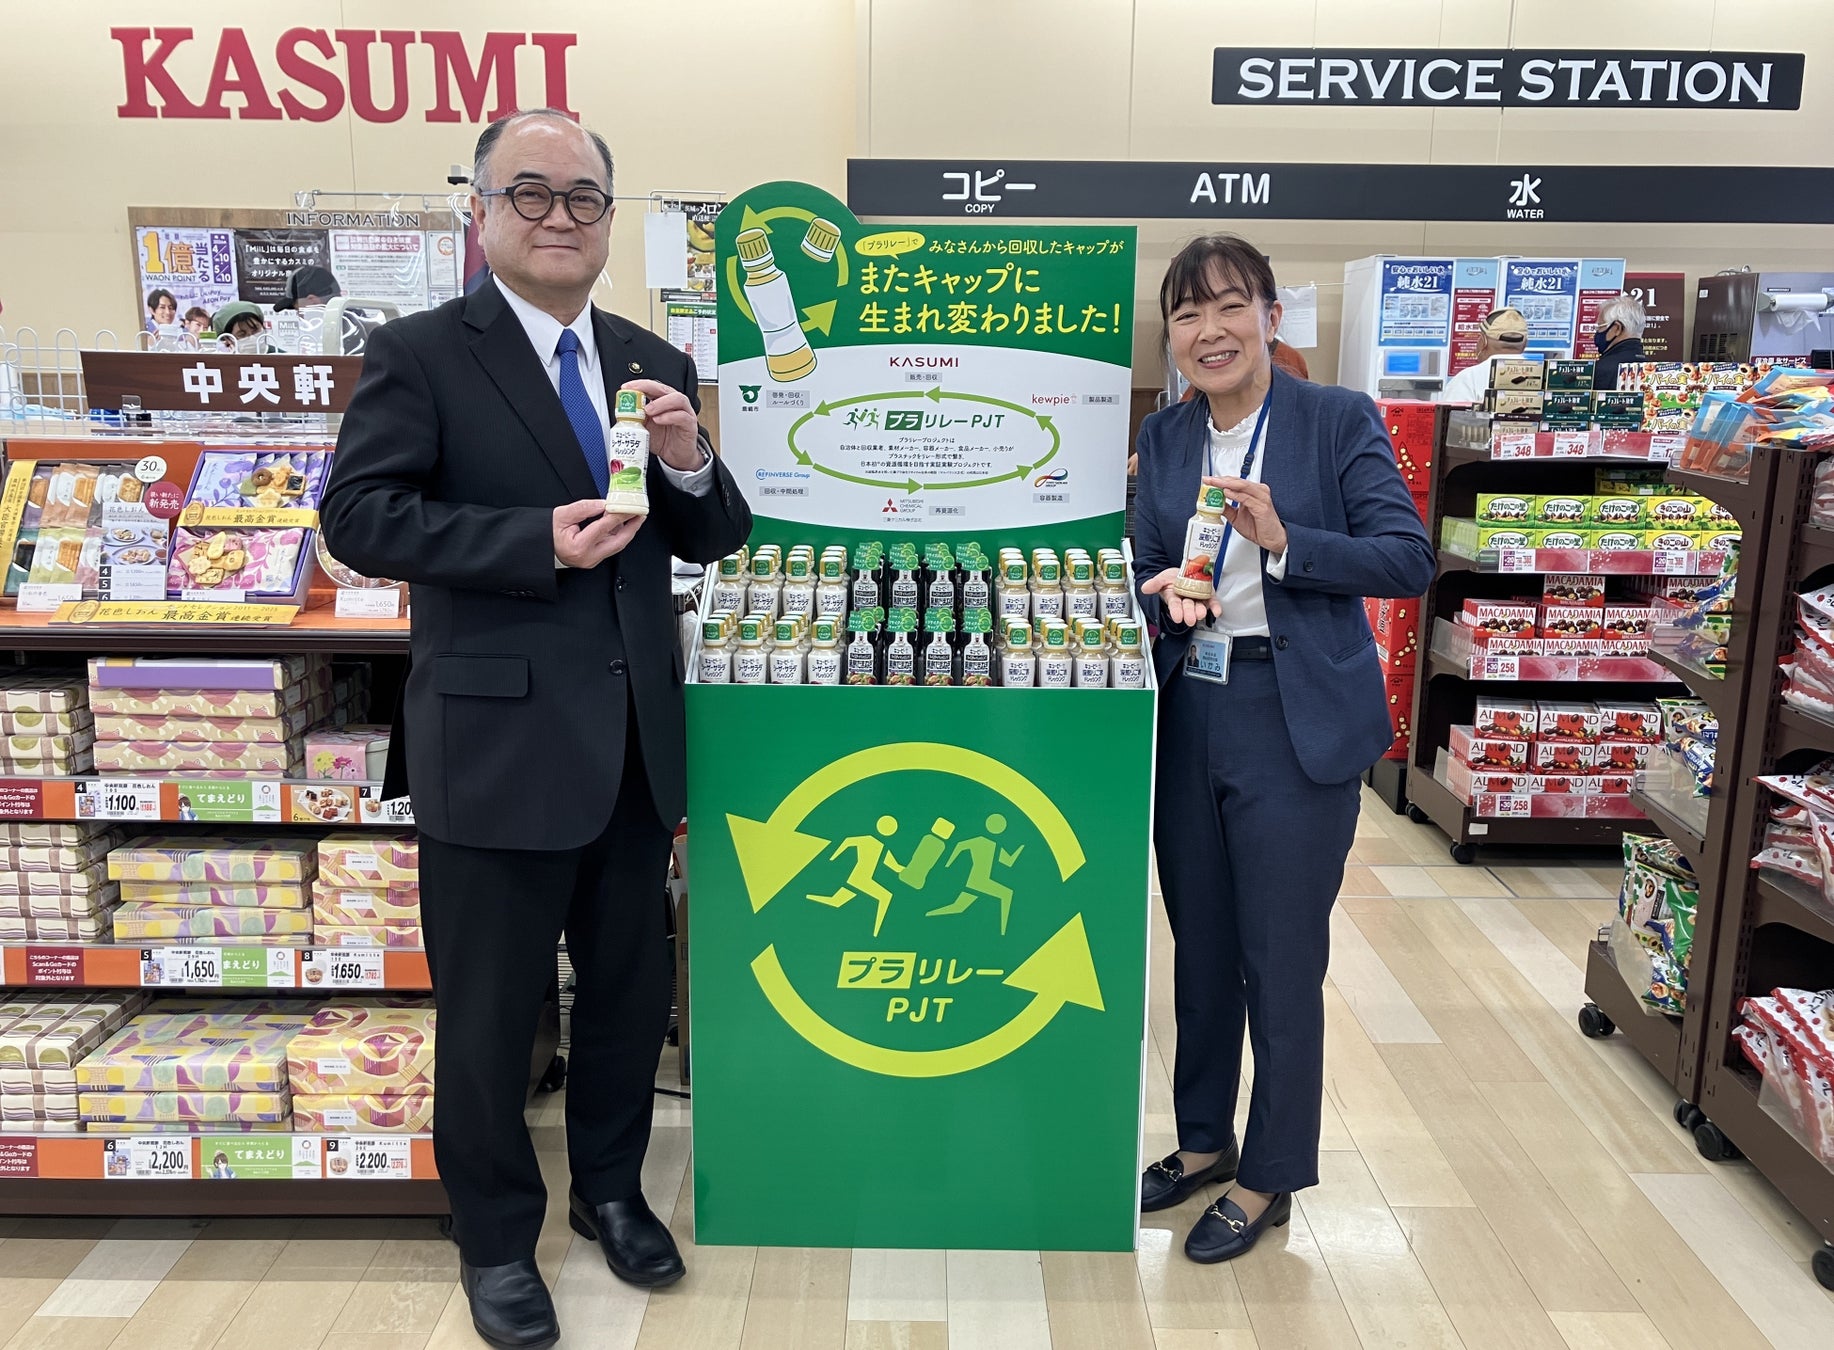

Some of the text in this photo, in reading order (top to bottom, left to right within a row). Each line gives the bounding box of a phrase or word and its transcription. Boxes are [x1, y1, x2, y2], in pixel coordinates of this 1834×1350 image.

[110, 27, 580, 123] KASUMI
[1237, 57, 1774, 105] SERVICE STATION
[941, 170, 1037, 200] コピー
[1190, 172, 1271, 204] ATM
[1508, 174, 1541, 207] 水
[964, 203, 996, 213] COPY
[286, 212, 420, 227] INFORMATION
[1507, 209, 1544, 220] WATER
[929, 239, 1123, 255] みなさんから回収したキャップが
[145, 274, 197, 282] WAON POINT
[859, 261, 1041, 295] またキャップに
[1397, 275, 1438, 289] 純水21
[1520, 277, 1562, 291] 純水21
[1622, 288, 1657, 307] 21
[859, 300, 1121, 335] 生まれ変わりました!
[889, 356, 959, 368] KASUMI
[182, 363, 335, 405] 中央軒
[1649, 374, 1689, 386] パイの実
[1706, 374, 1746, 386] パイの実
[1032, 394, 1070, 406] kewpie
[1651, 418, 1688, 430] パイの実
[1514, 445, 1532, 457] 348
[1567, 444, 1585, 455] 348
[149, 499, 180, 510] 新発売
[1490, 502, 1526, 511] たけのこの里
[1546, 503, 1581, 513] たけのこの里
[1601, 504, 1637, 513] たけのこの里
[1660, 505, 1692, 514] きのこの山
[233, 514, 277, 523] 最高金賞
[1490, 537, 1525, 546] たけのこの里
[1545, 537, 1580, 546] たけのこの里
[1600, 538, 1636, 547] たけのこの里
[1658, 538, 1689, 547] きのこの山
[1546, 575, 1603, 586] MACADAMIA
[162, 610, 230, 621] 最高金賞
[1479, 608, 1534, 618] MACADAMIA
[1548, 608, 1602, 619] MACADAMIA
[1607, 609, 1660, 619] MACADAMIA
[1490, 639, 1542, 650] MACADAMIA
[1546, 639, 1598, 650] MACADAMIA
[1501, 662, 1515, 673] 258
[1480, 709, 1535, 723] ALMOND
[1542, 712, 1599, 726] ALMOND
[1602, 711, 1658, 724] ALMOND
[1471, 742, 1525, 754] ALMOND
[1541, 745, 1593, 757] ALMOND
[1598, 745, 1649, 756] ALMOND
[77, 782, 83, 791] 4
[1473, 776, 1527, 787] ALMOND
[1531, 777, 1584, 788] ALMOND
[361, 788, 368, 796] 7
[108, 794, 136, 811] 1,100
[197, 793, 245, 804] てまえどり
[1513, 800, 1529, 811] 258
[143, 951, 150, 959] 5
[304, 952, 310, 960] 8
[223, 960, 260, 969] まえどり
[334, 963, 361, 979] 1,650
[848, 956, 1004, 985] プラリレー
[886, 997, 954, 1023] PJT
[107, 1142, 114, 1150] 6
[329, 1142, 336, 1150] 9
[234, 1149, 285, 1160] てまえどり
[359, 1152, 387, 1169] 2,200
